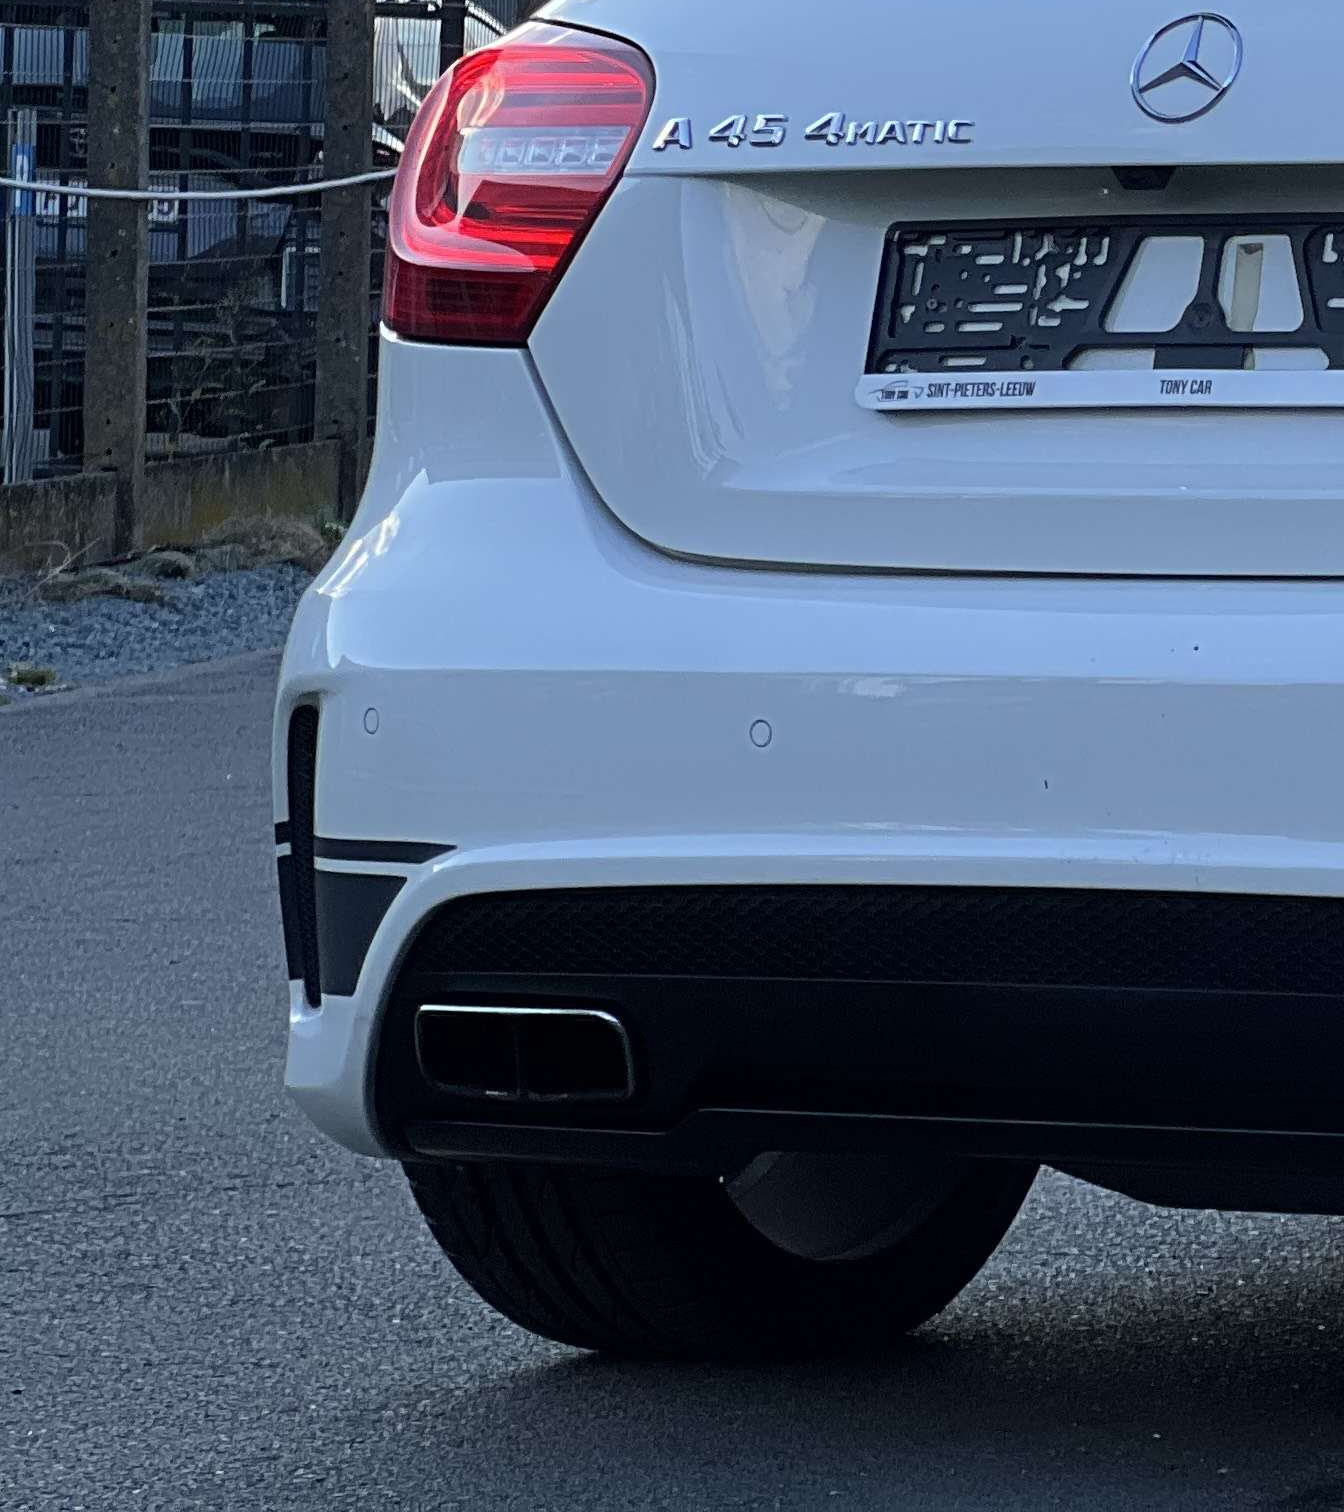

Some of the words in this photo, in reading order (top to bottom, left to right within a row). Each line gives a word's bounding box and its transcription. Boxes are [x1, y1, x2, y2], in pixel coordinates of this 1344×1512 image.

[652, 116, 692, 151] A
[708, 113, 788, 148] 45
[926, 381, 1036, 398] SINT-PIETERS-LEEUW
[1160, 379, 1188, 394] TONY
[1189, 379, 1213, 394] CAR
